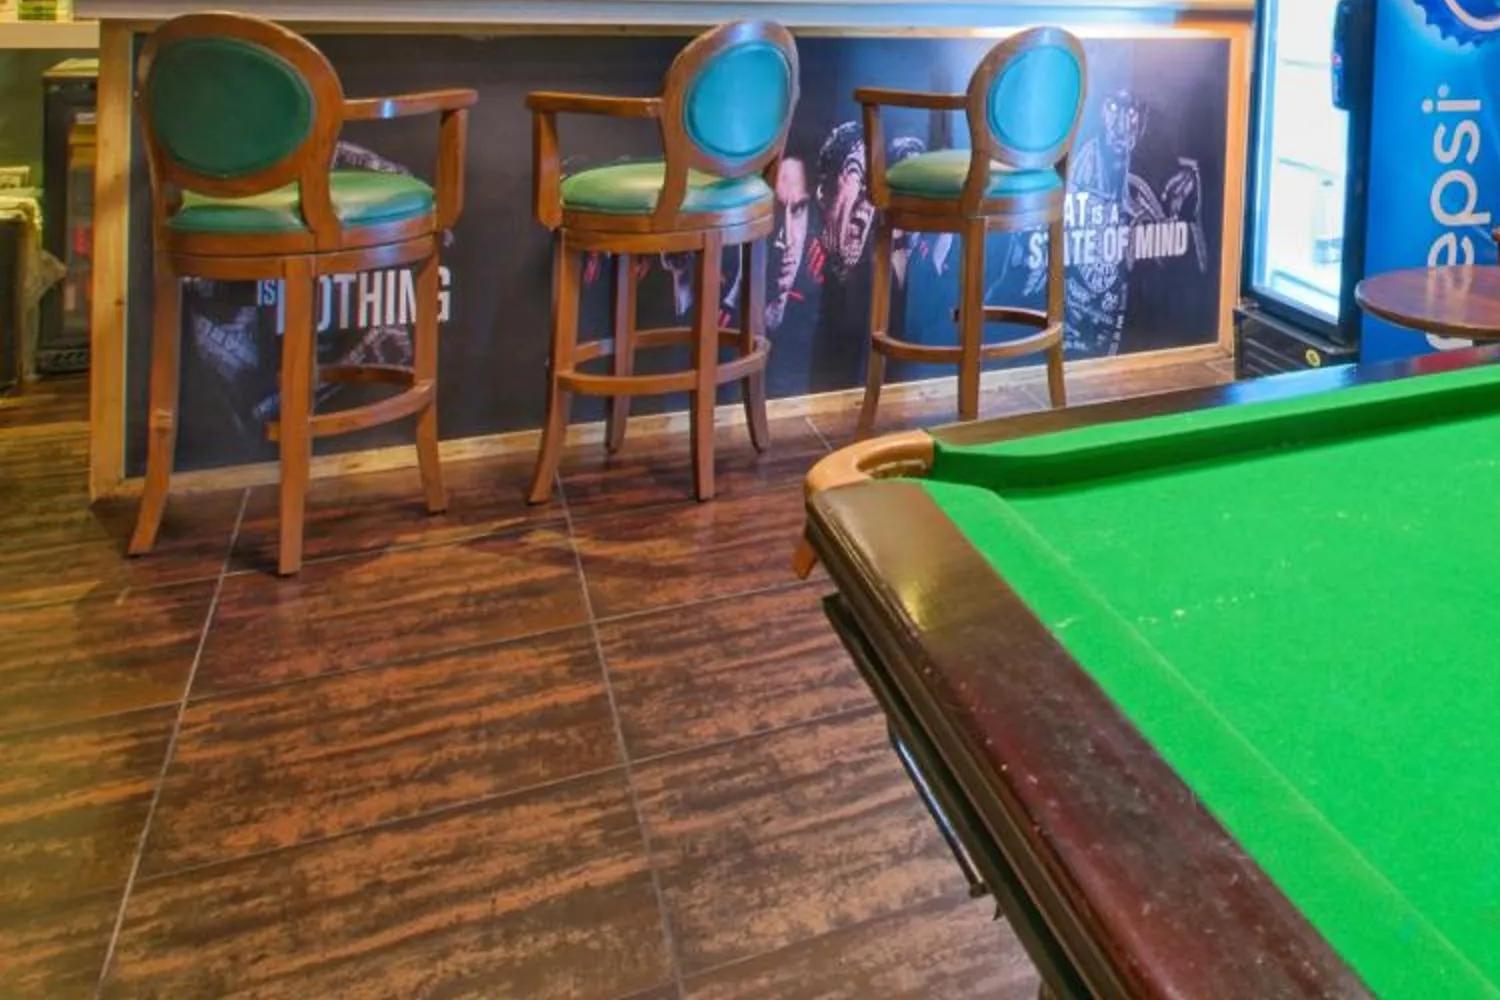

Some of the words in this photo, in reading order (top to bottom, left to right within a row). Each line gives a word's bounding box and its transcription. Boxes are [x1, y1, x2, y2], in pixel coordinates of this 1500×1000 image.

[1103, 225, 1129, 263] OF
[1135, 221, 1188, 259] MIND
[1422, 84, 1491, 350] epsi
